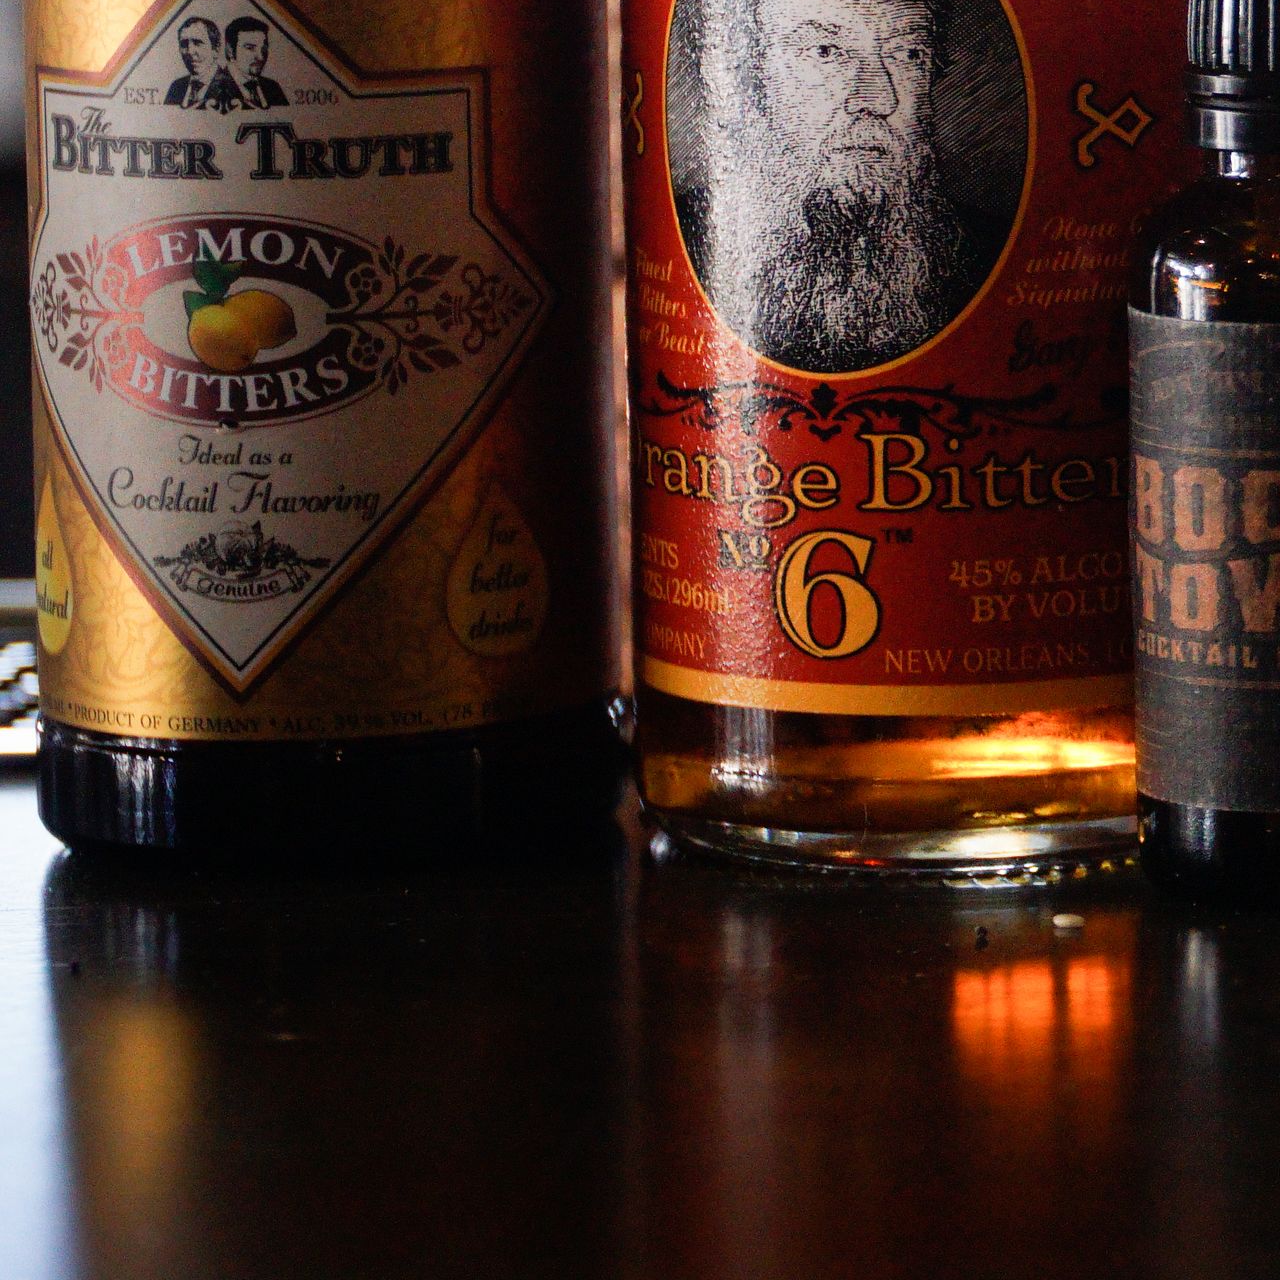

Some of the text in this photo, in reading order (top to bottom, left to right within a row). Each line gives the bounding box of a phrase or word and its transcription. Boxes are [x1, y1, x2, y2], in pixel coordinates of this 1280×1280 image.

[123, 87, 340, 106] EST. 2006
[126, 226, 345, 281] LEMON
[127, 352, 351, 416] BITTERS
[176, 433, 294, 469] Ideal as a
[106, 465, 383, 522] Cocktail Flavoring
[642, 431, 1130, 528] range Bitter
[949, 552, 1124, 591] 45% ALCO
[774, 528, 882, 660] 6
[971, 584, 1123, 624] BY VOLU
[884, 648, 955, 676] NEW
[1137, 632, 1259, 671] COCKTAIL
[74, 700, 133, 729] PRODUCT
[140, 712, 163, 730] OF
[168, 714, 261, 734] GERMANY
